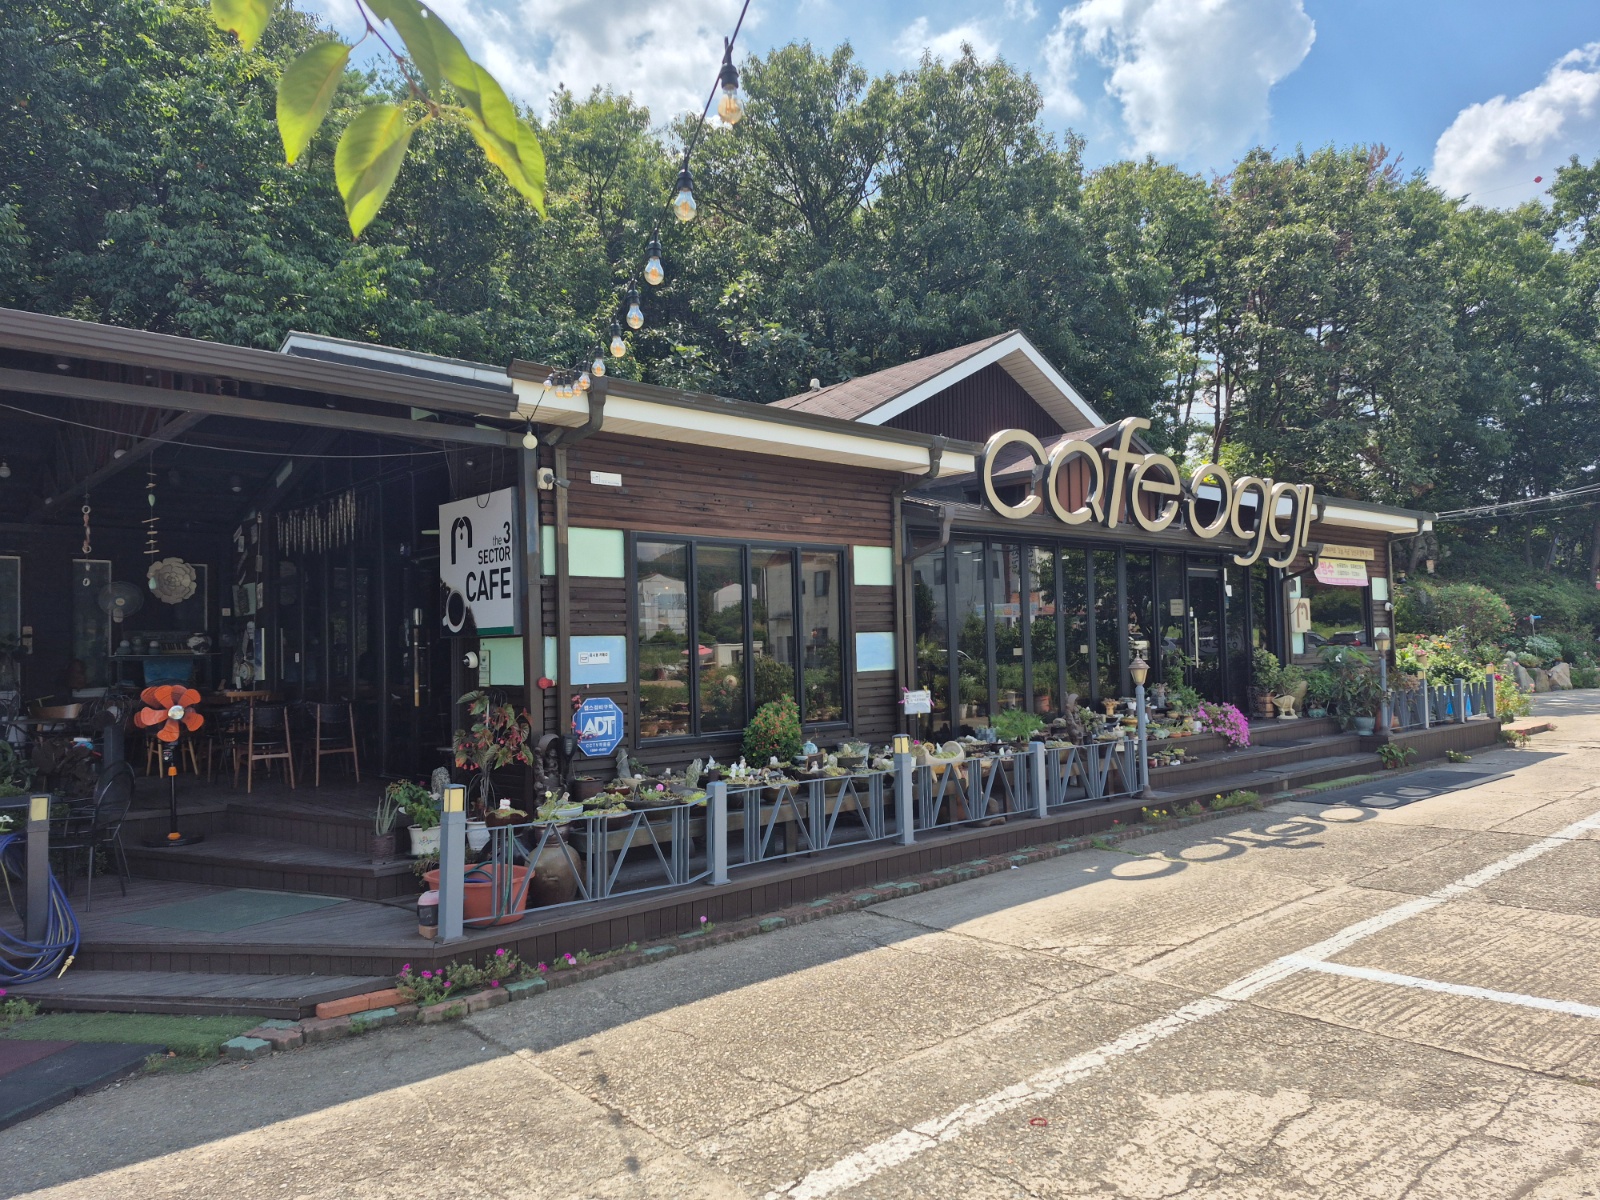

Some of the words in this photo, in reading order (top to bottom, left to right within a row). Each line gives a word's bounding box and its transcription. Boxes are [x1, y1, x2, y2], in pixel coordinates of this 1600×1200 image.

[492, 534, 503, 547] the
[503, 521, 511, 544] 3
[477, 545, 511, 565] SECTOR
[465, 566, 512, 602] CAFE
[581, 715, 617, 738] ADT
